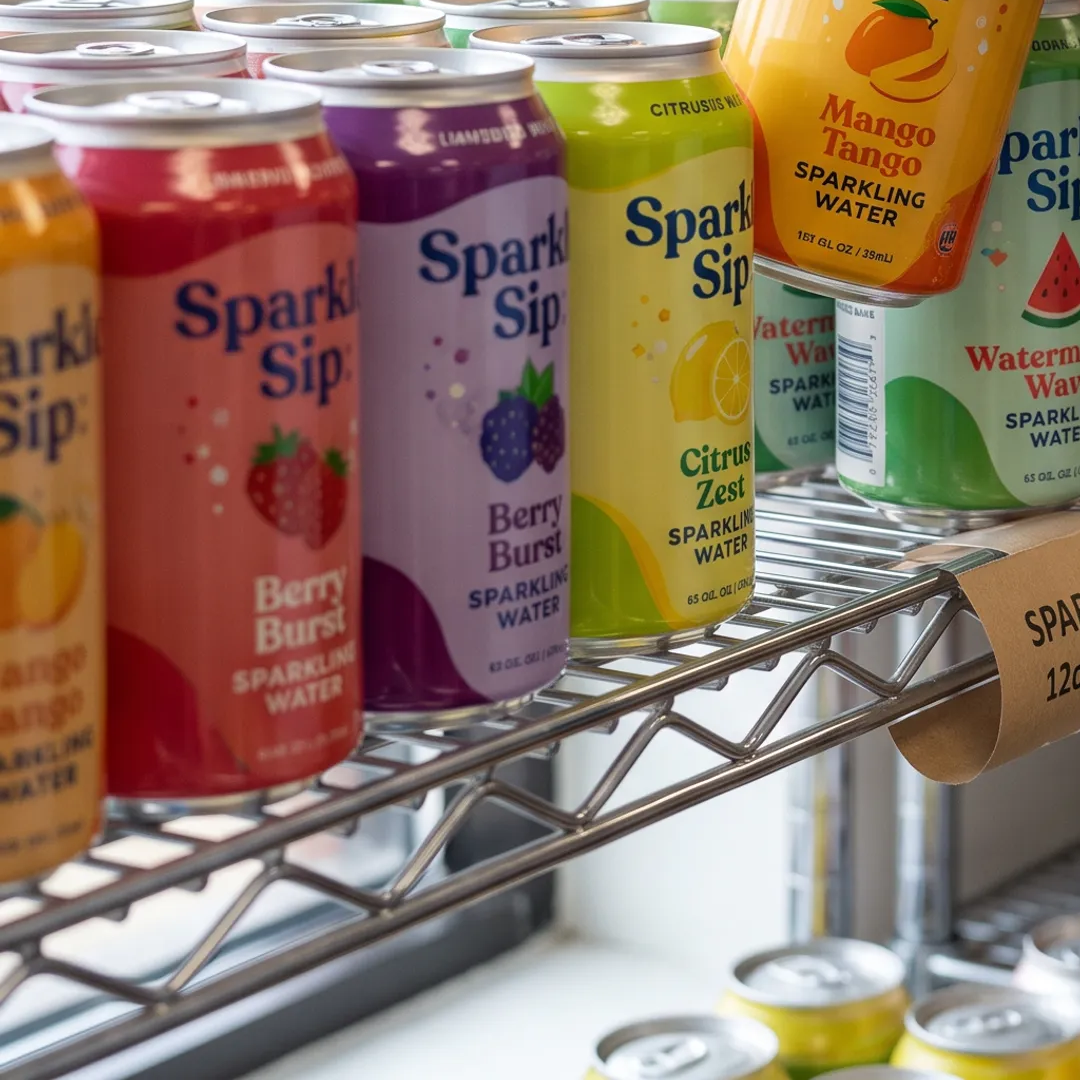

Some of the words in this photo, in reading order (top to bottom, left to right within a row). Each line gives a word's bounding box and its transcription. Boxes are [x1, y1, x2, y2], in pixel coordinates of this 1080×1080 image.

[819, 93, 936, 148] Mango
[822, 126, 923, 178] Tango
[794, 161, 926, 209] SPARKLING
[625, 179, 753, 259] Spark
[815, 190, 899, 227] WATER
[174, 257, 358, 353] Sparkl
[754, 314, 835, 341] aterm
[769, 371, 835, 395] SPARK
[680, 441, 751, 478] Citrus
[696, 474, 745, 510] Zest
[487, 494, 563, 534] Berry
[488, 529, 562, 572] Burst
[694, 533, 748, 565] WATER
[254, 566, 347, 614] Berry
[254, 605, 346, 655] Burst
[497, 594, 560, 630] WATER
[232, 639, 357, 695] SPARKLIN
[264, 674, 343, 715] WATER
